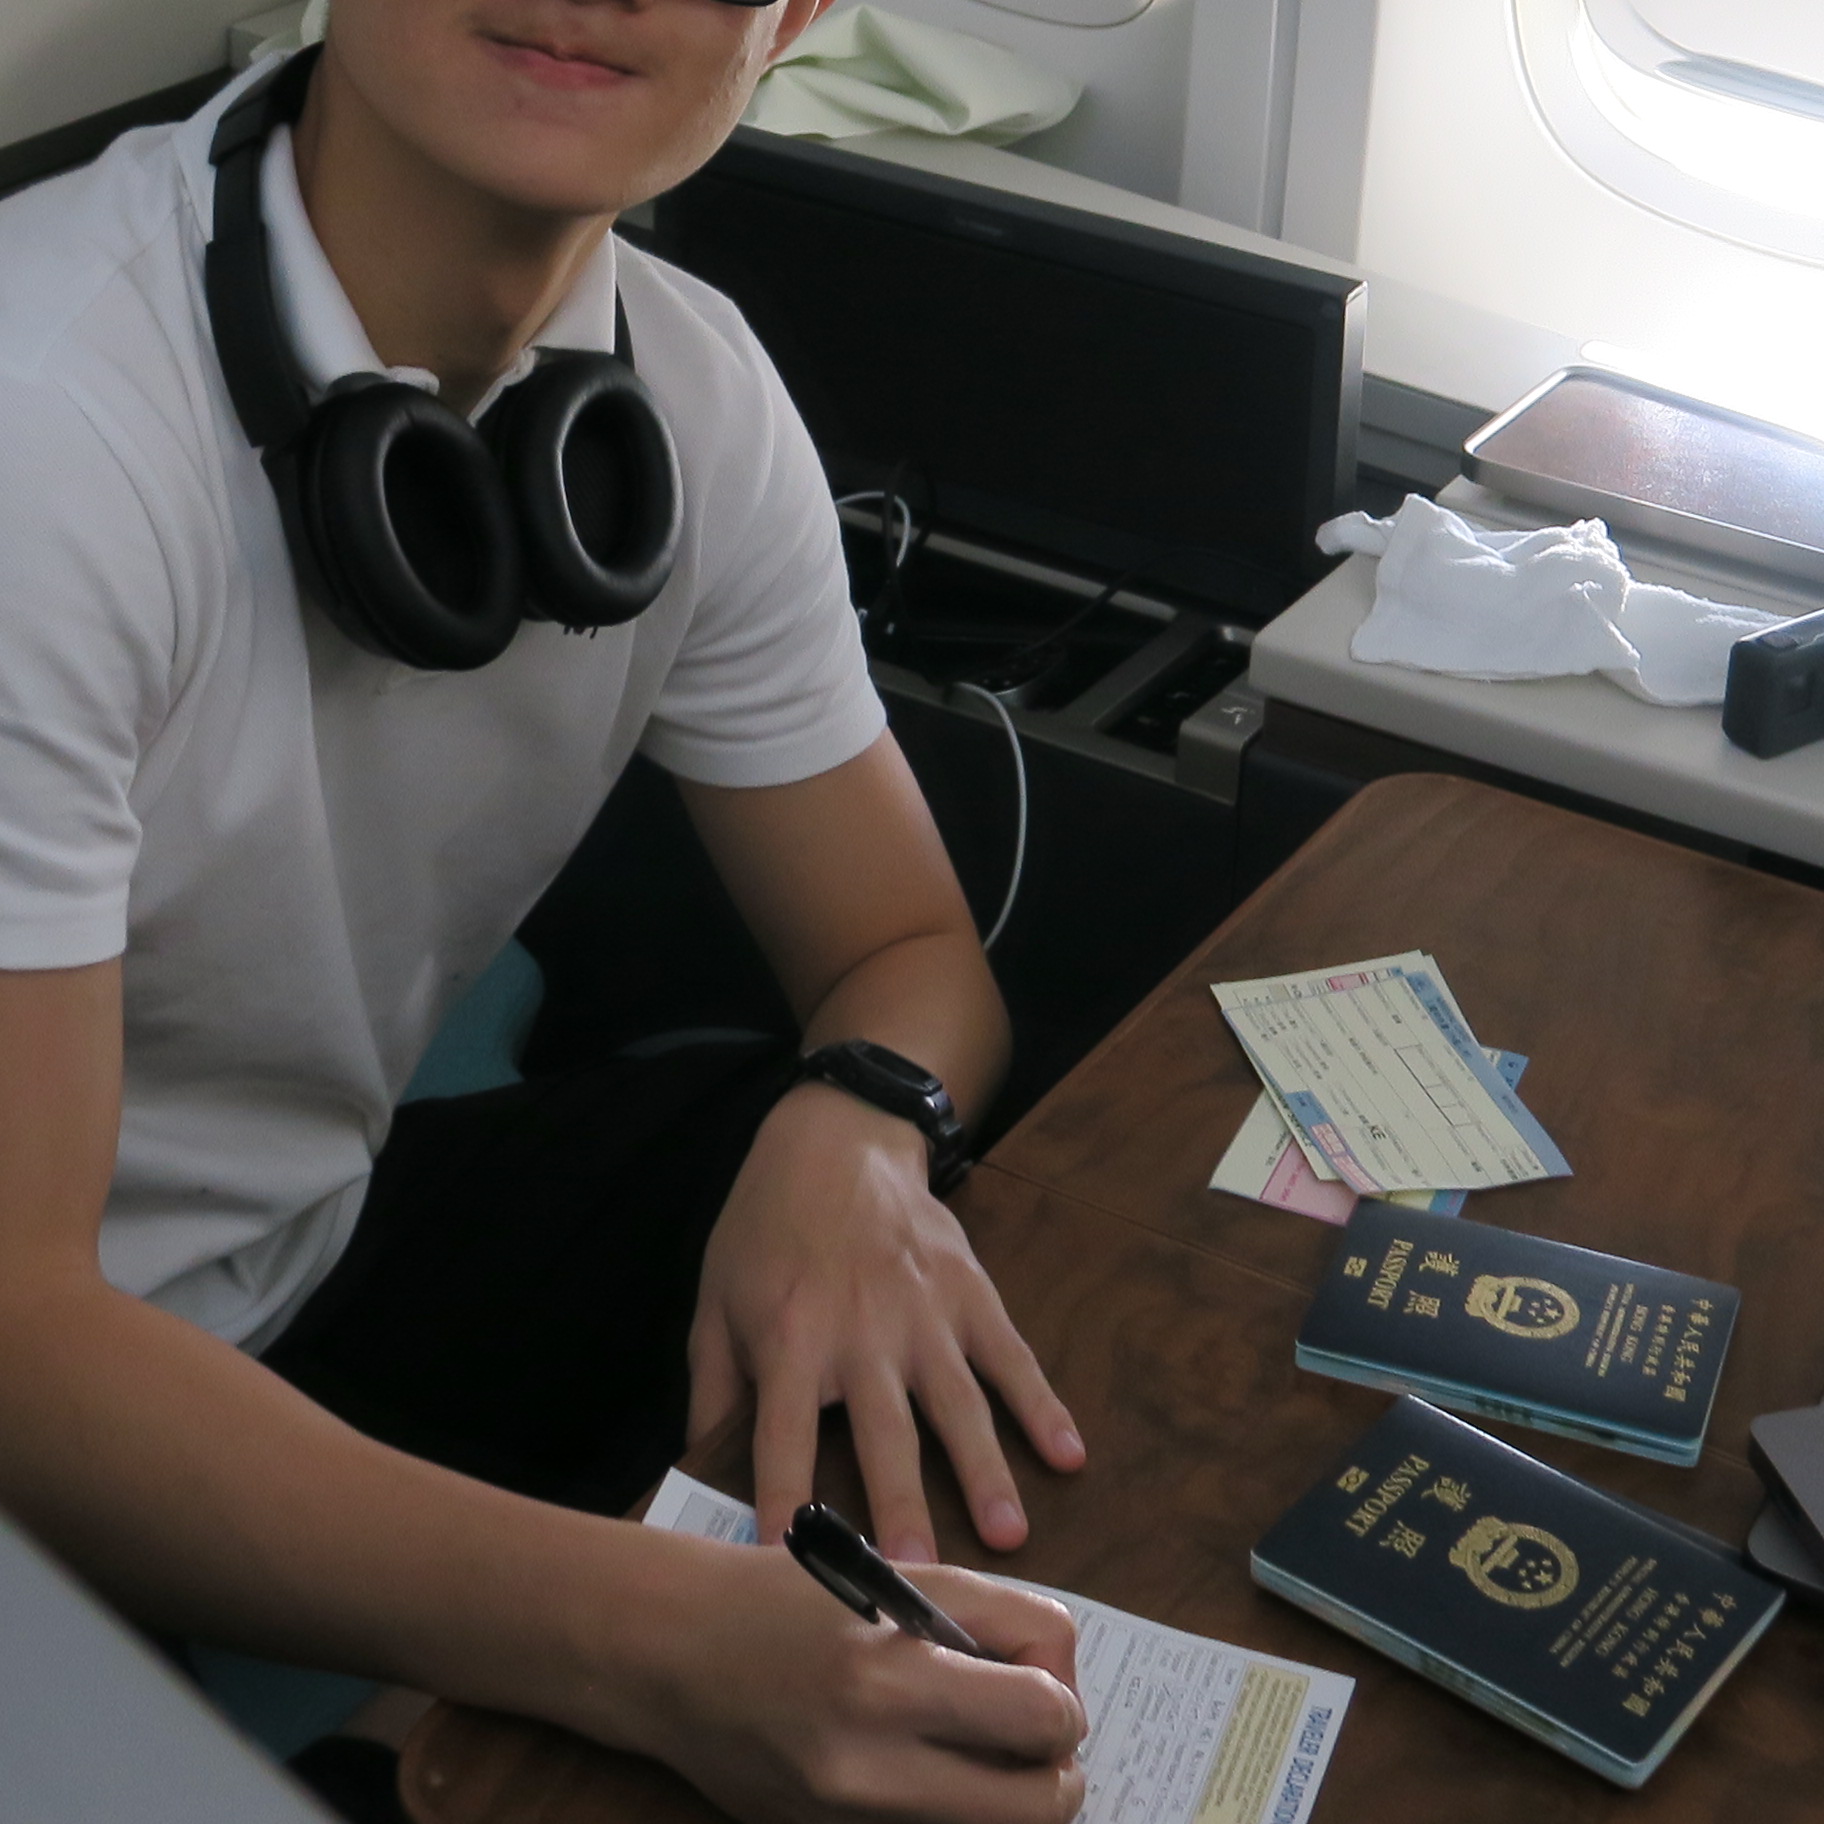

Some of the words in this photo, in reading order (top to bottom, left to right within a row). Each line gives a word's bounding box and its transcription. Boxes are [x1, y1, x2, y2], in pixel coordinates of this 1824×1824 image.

[1367, 1238, 1415, 1310] PASSPORT
[1403, 1250, 1461, 1318] 護照
[1663, 1298, 1714, 1402] 中華人民共和國
[1344, 1453, 1430, 1538] PASSPORT
[1378, 1475, 1473, 1559] 護照
[1594, 1623, 1629, 1657] KONG
[1625, 1586, 1659, 1620] HONG
[1622, 1592, 1737, 1718] 中華人民共和國
